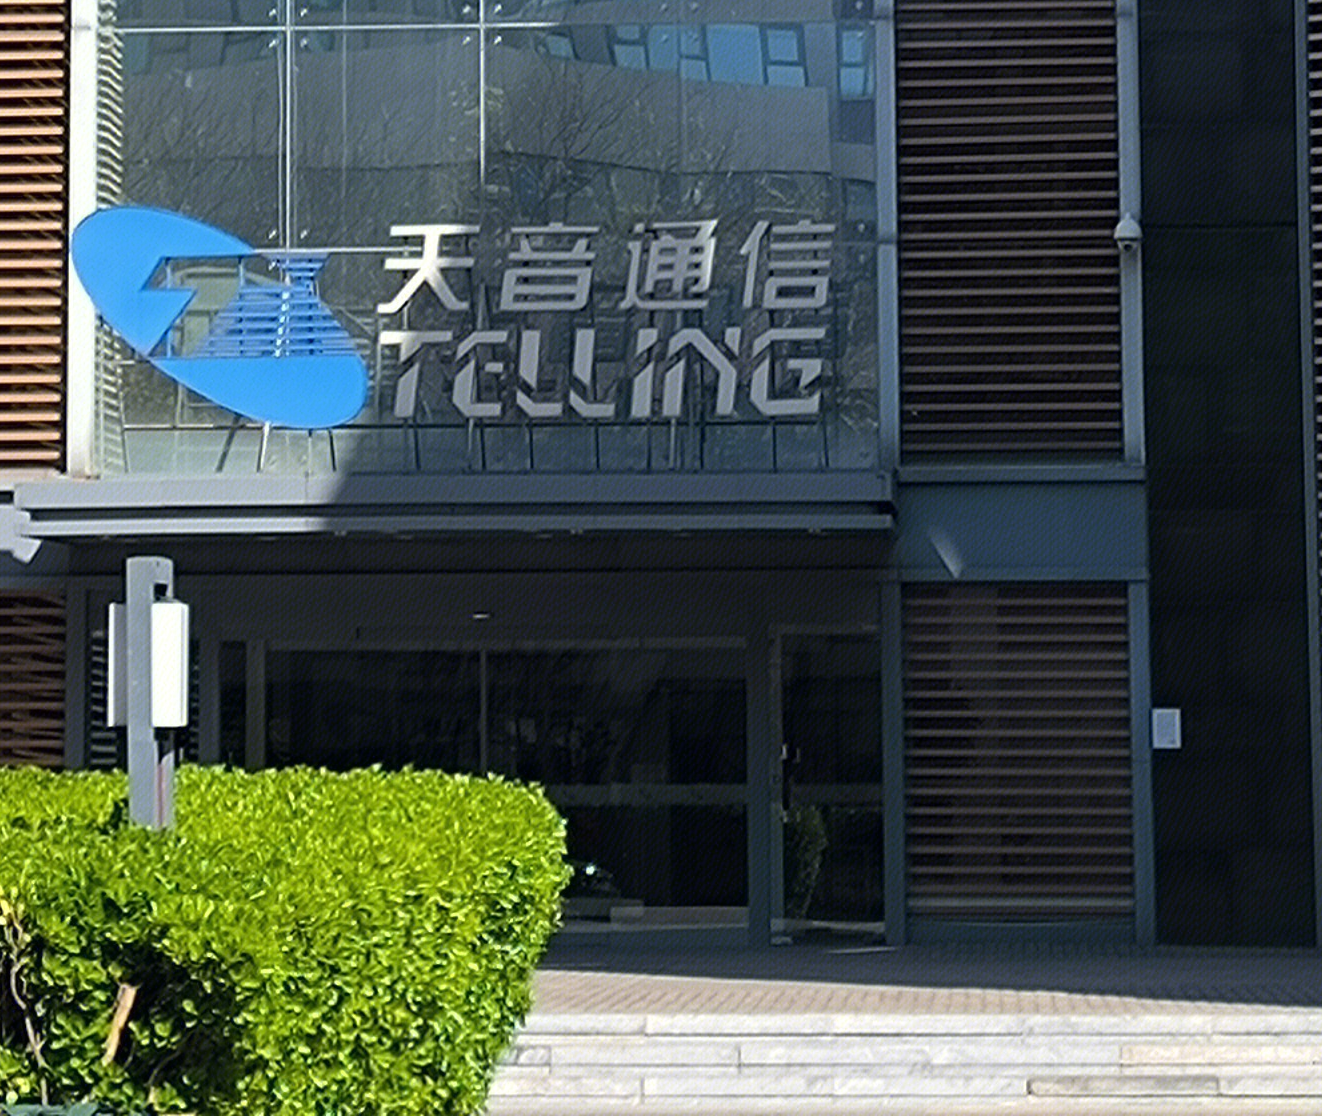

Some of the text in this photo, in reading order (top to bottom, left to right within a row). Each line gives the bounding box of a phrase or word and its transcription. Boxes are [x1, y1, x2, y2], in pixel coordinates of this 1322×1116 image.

[376, 218, 837, 314] 天音通信
[378, 327, 827, 419] TELLING
